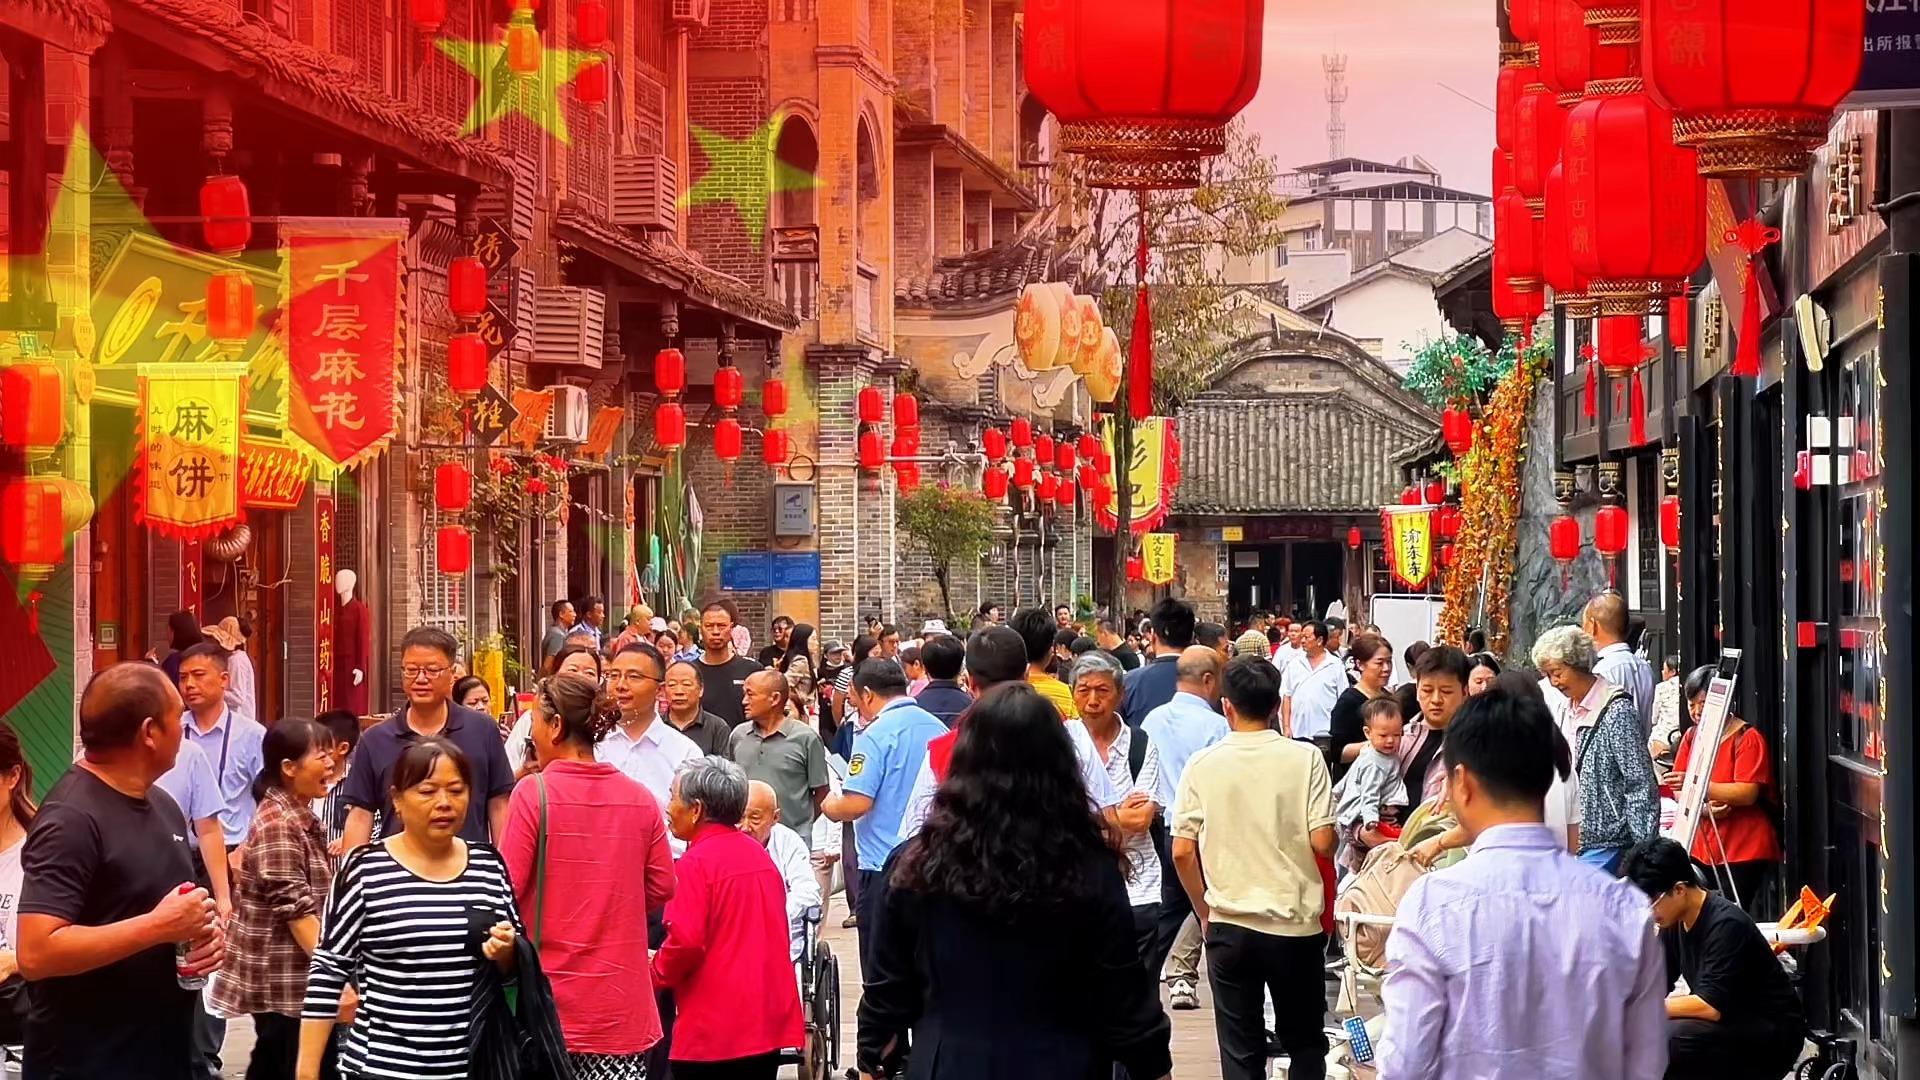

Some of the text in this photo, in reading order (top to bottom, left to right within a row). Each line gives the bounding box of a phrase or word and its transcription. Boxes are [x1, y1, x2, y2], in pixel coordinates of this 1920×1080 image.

[310, 260, 369, 430] 千层麻花
[169, 401, 215, 498] 麻饼
[319, 509, 331, 713] 香脆山药片
